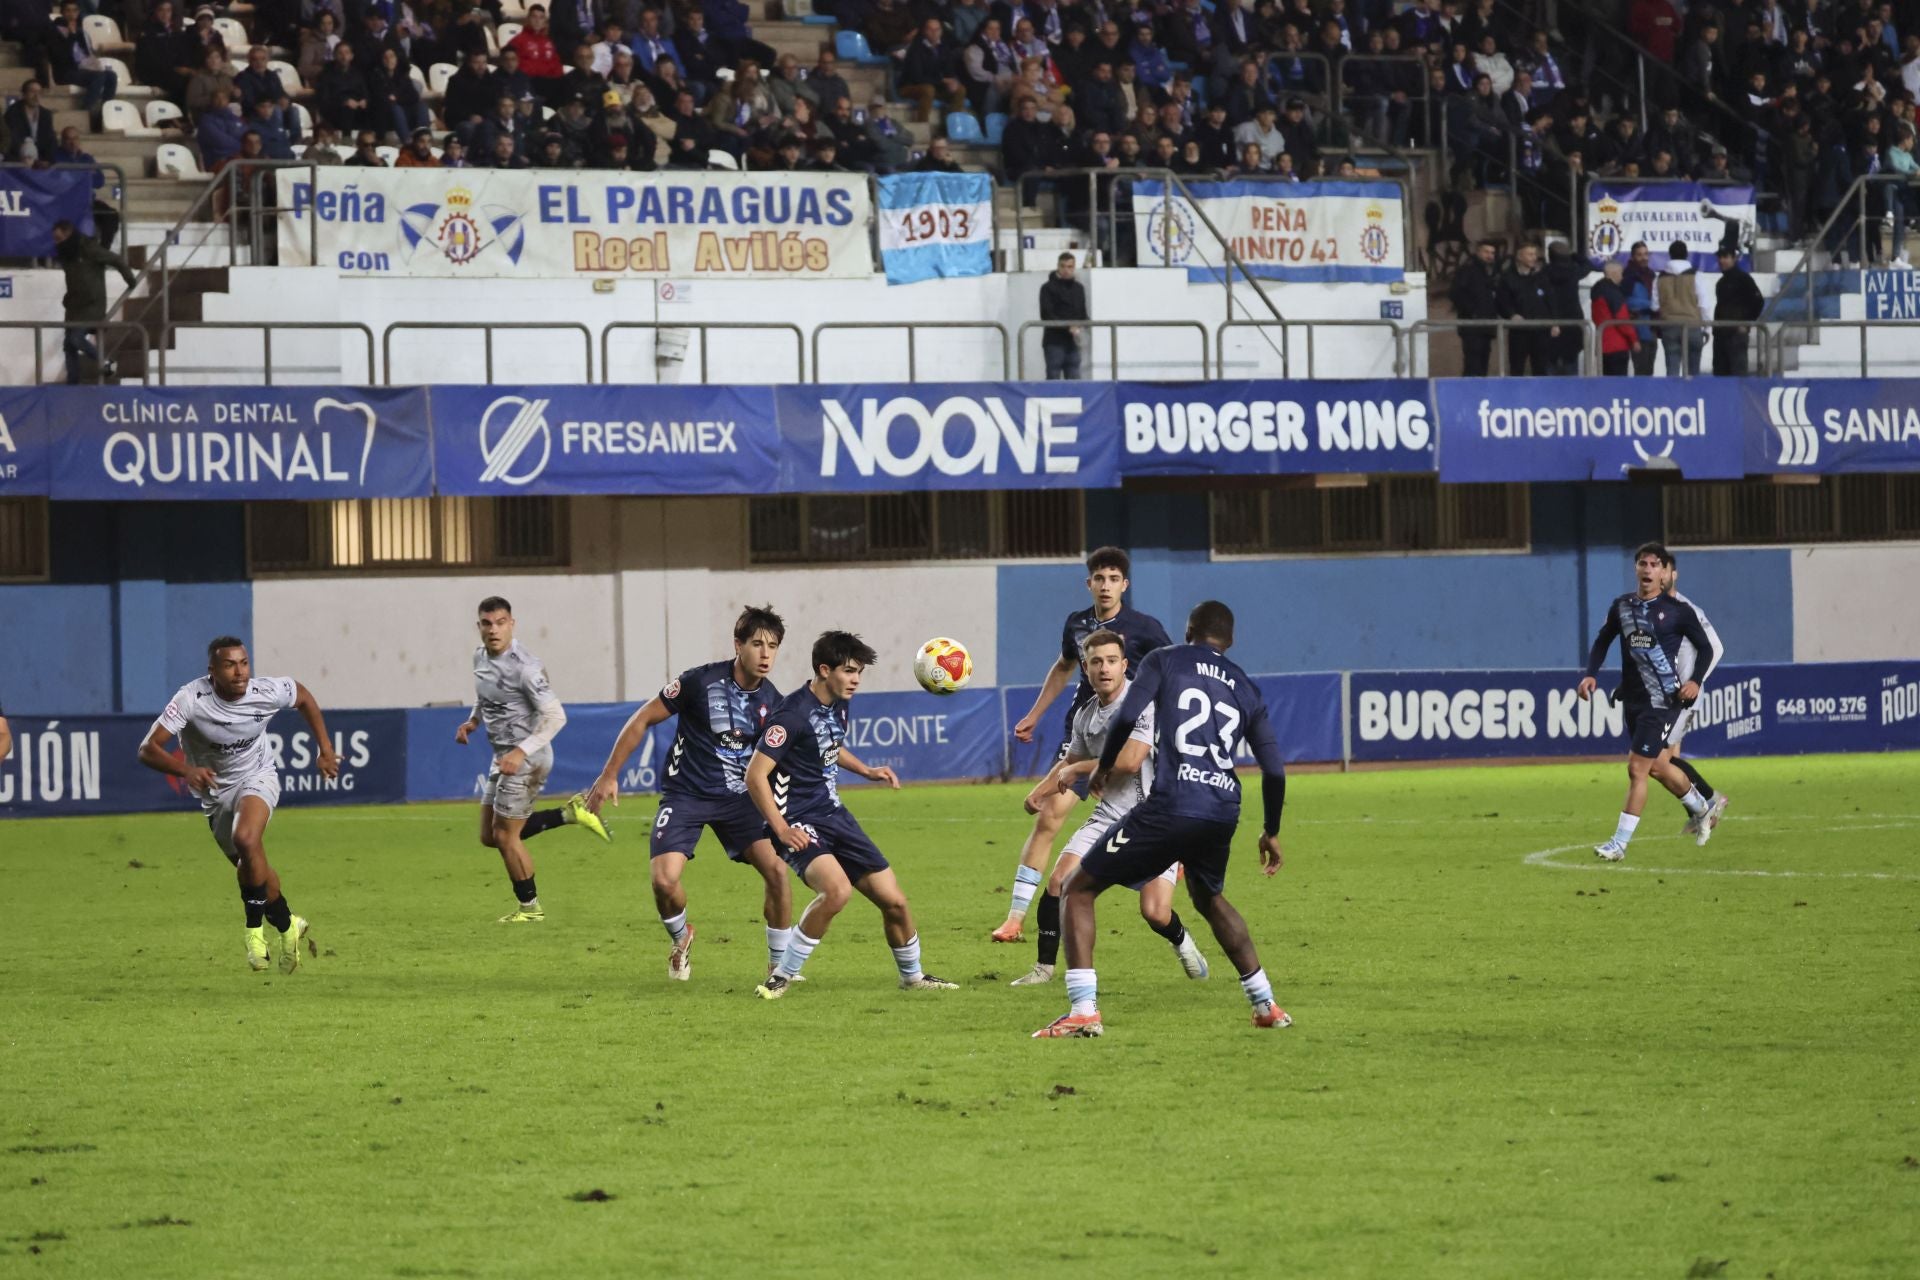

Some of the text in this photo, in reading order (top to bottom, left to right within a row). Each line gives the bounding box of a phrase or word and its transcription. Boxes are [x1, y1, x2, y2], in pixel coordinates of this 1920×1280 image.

[293, 183, 385, 223] Peña
[539, 185, 854, 226] EL PARAGUAS
[1251, 202, 1308, 232] PEÑA
[338, 250, 390, 271] con
[573, 231, 830, 271] Real Avilés
[1310, 238, 1338, 262] 42
[1877, 293, 1920, 318] FAN
[102, 399, 298, 423] CLÍNICA DENTAL
[1124, 400, 1430, 453] BURGER KING
[1478, 398, 1706, 438] fanemotional
[562, 420, 738, 455] FRESAMEX
[820, 396, 1083, 476] NOONE
[103, 432, 349, 486] QUIRINAL
[1196, 662, 1235, 690] MILLA
[1882, 674, 1899, 687] THE
[1359, 689, 1536, 741] BURGER
[1776, 696, 1867, 715] 648 100 376
[1881, 681, 1920, 725] ROD
[1175, 687, 1240, 769] 23
[1727, 715, 1762, 740] BURGER
[278, 773, 355, 791] RNING
[656, 808, 673, 828] 6
